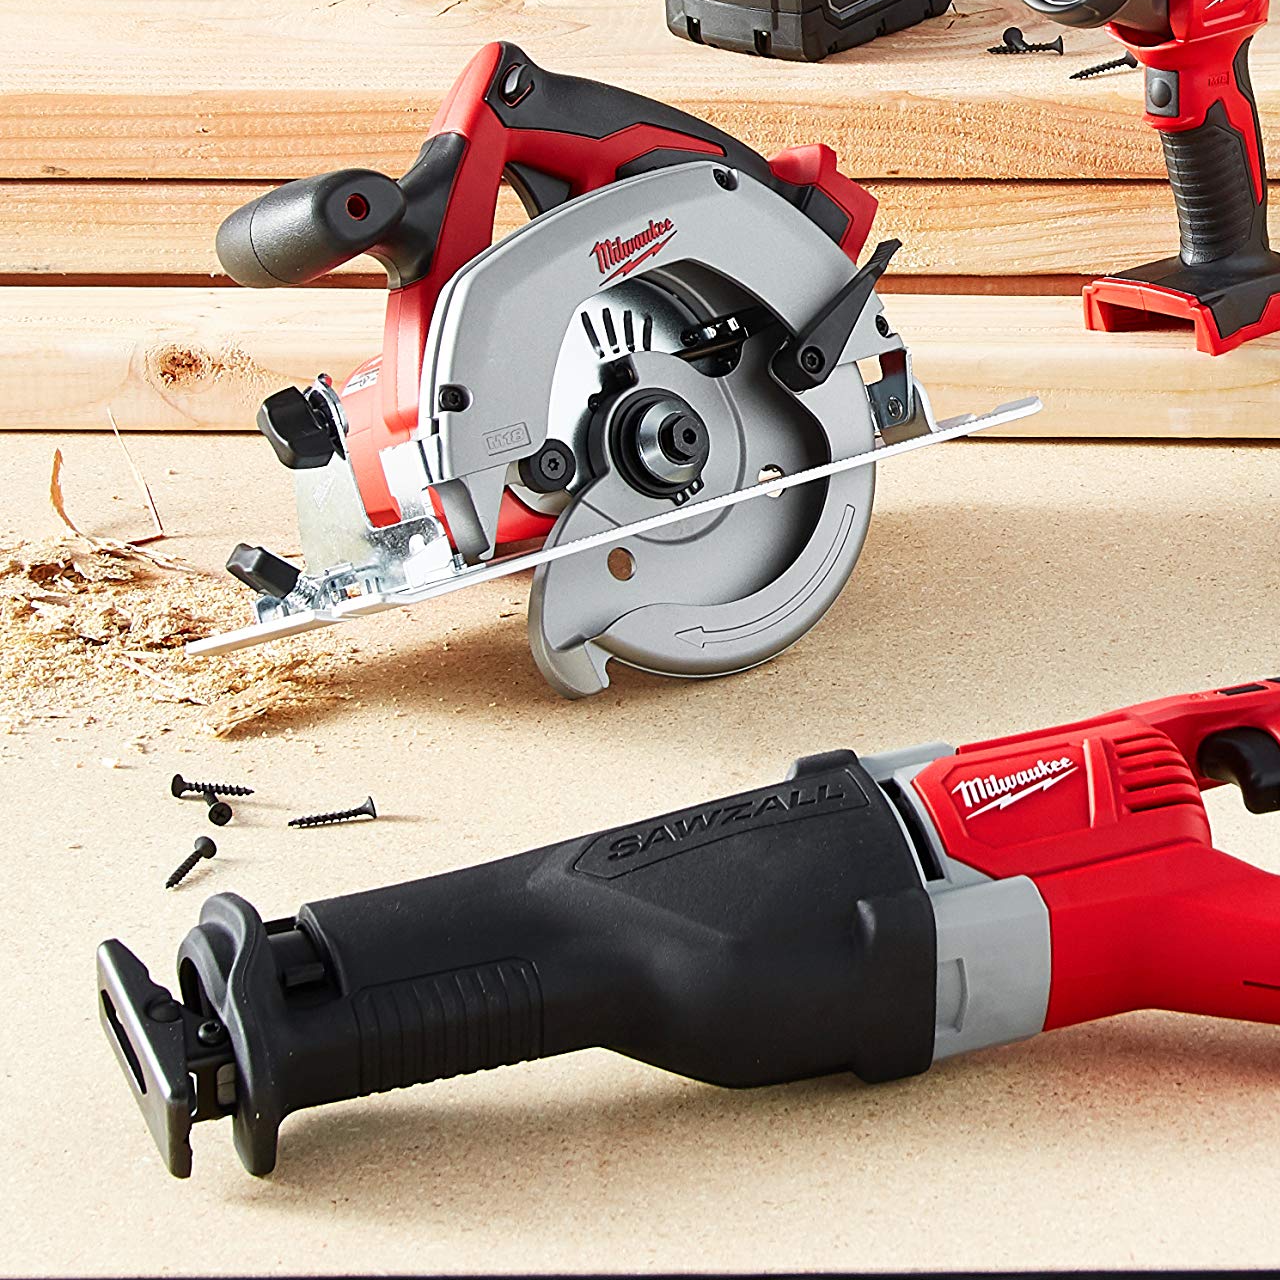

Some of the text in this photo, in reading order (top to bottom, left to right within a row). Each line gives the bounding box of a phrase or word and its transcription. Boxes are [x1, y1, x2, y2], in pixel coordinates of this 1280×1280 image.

[589, 218, 675, 274] Milwaukee
[486, 427, 525, 450] M18
[951, 757, 1074, 808] Milwaukee
[607, 783, 846, 862] SAWZALL
